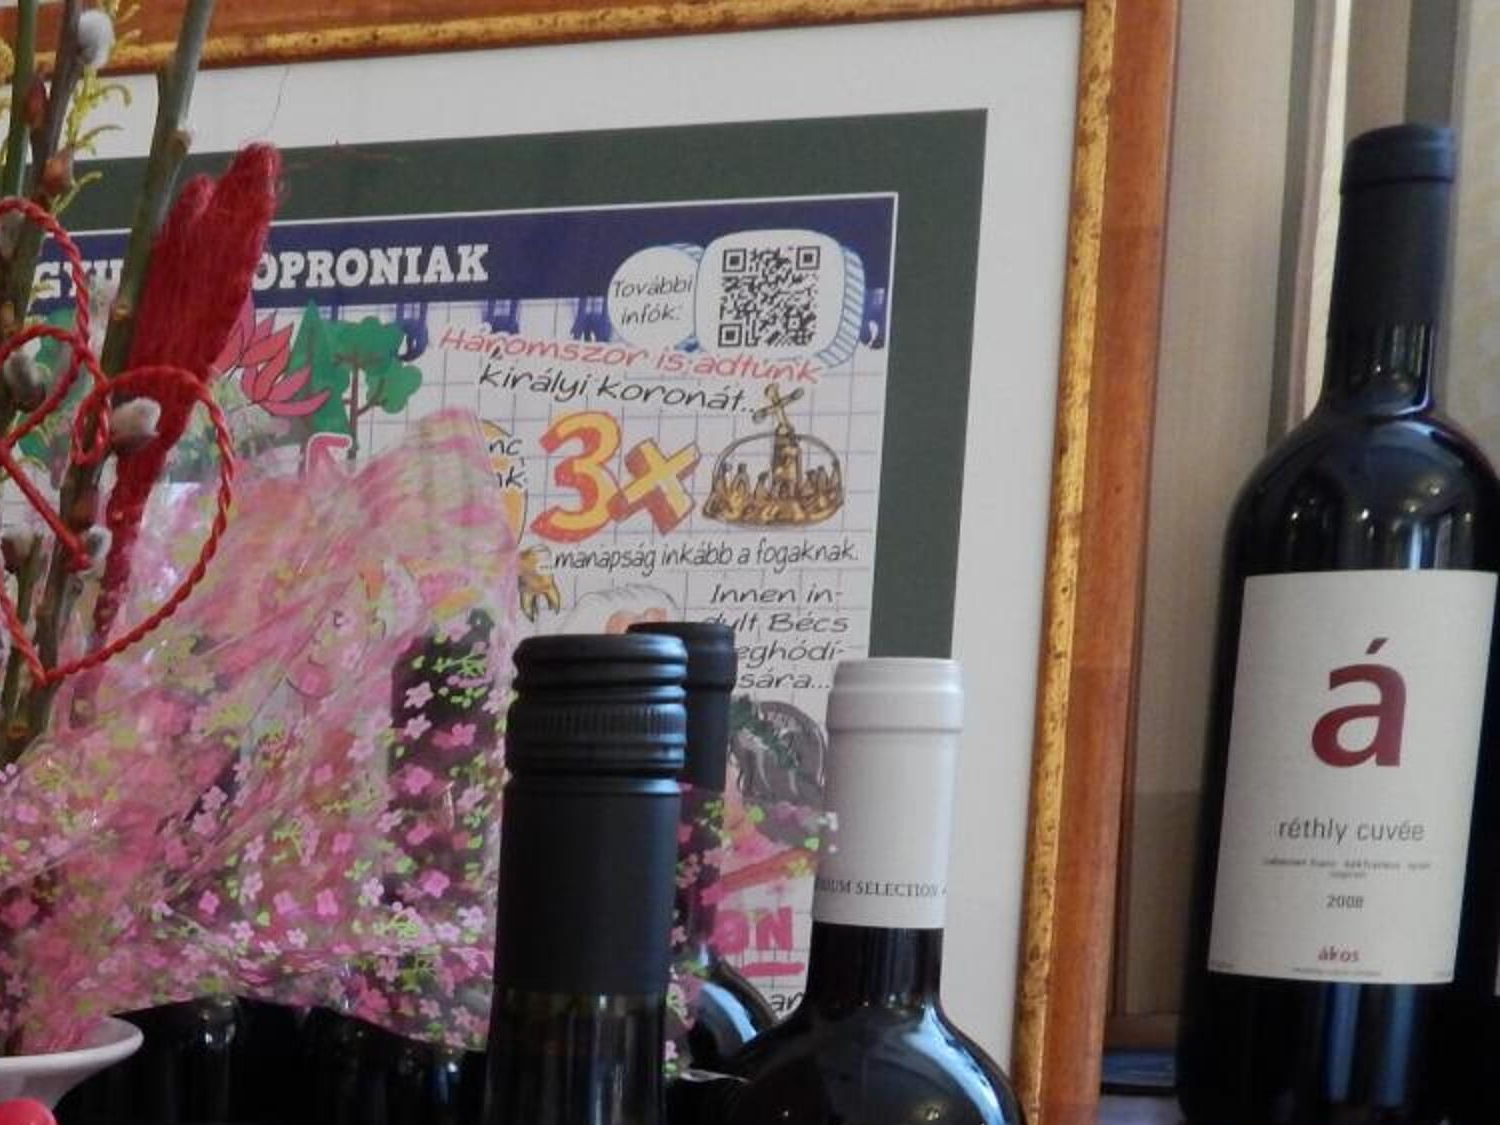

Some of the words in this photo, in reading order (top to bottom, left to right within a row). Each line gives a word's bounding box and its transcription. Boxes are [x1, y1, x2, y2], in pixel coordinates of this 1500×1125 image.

[253, 244, 489, 291] OPRONIAK
[613, 277, 693, 298] További
[621, 305, 681, 325] infók:
[440, 328, 648, 368] Háromszor
[479, 360, 588, 399] királyi
[530, 411, 702, 544] 3x
[660, 542, 733, 568] inkább
[736, 548, 751, 564] a
[755, 538, 860, 576] fogaknak.
[710, 584, 797, 604] Innen
[806, 583, 844, 604] in-
[768, 610, 850, 633] Bécs
[737, 638, 845, 668] eghódí-
[738, 665, 831, 690] sára...
[1310, 636, 1407, 769] á
[1278, 815, 1348, 846] réthly
[1357, 818, 1426, 842] cuvée
[855, 880, 938, 897] SELECTION
[1317, 946, 1360, 962] ákos
